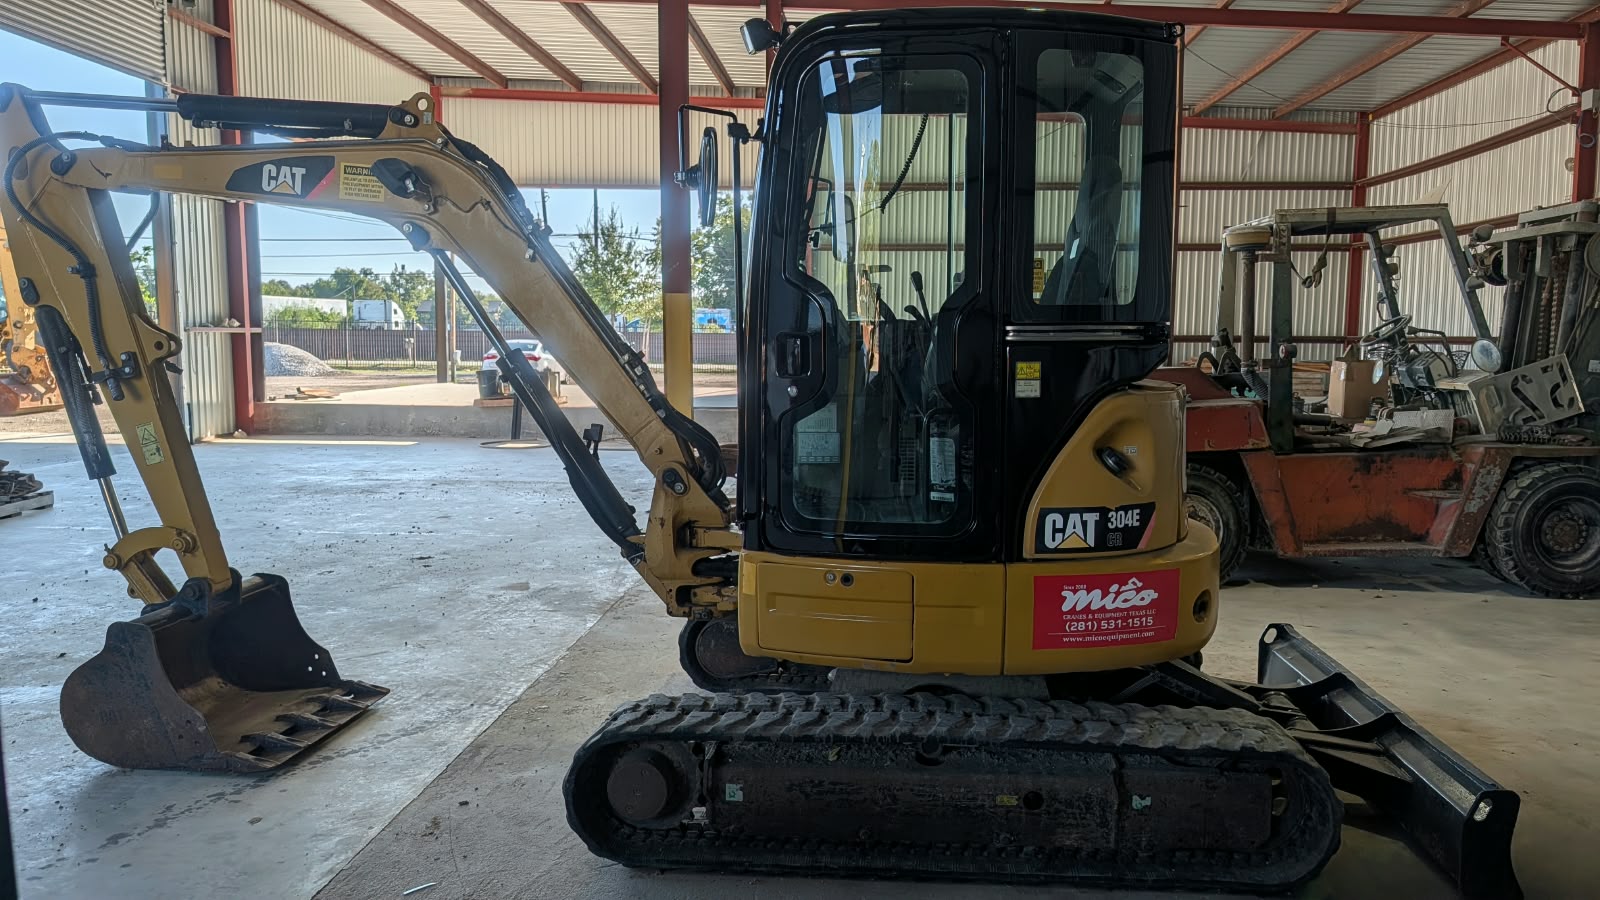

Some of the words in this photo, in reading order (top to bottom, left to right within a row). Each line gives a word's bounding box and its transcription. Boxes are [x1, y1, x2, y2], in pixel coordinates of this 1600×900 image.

[345, 166, 373, 176] WARNI
[261, 164, 306, 196] CAT
[1108, 509, 1140, 529] 304E
[1044, 512, 1100, 549] CAT
[1107, 532, 1123, 547] CR
[1094, 611, 1127, 619] EQUIPMENT
[1065, 621, 1098, 632] (281)
[1100, 616, 1153, 630] 531-1515
[1063, 631, 1155, 642] www.micoequipment.com
